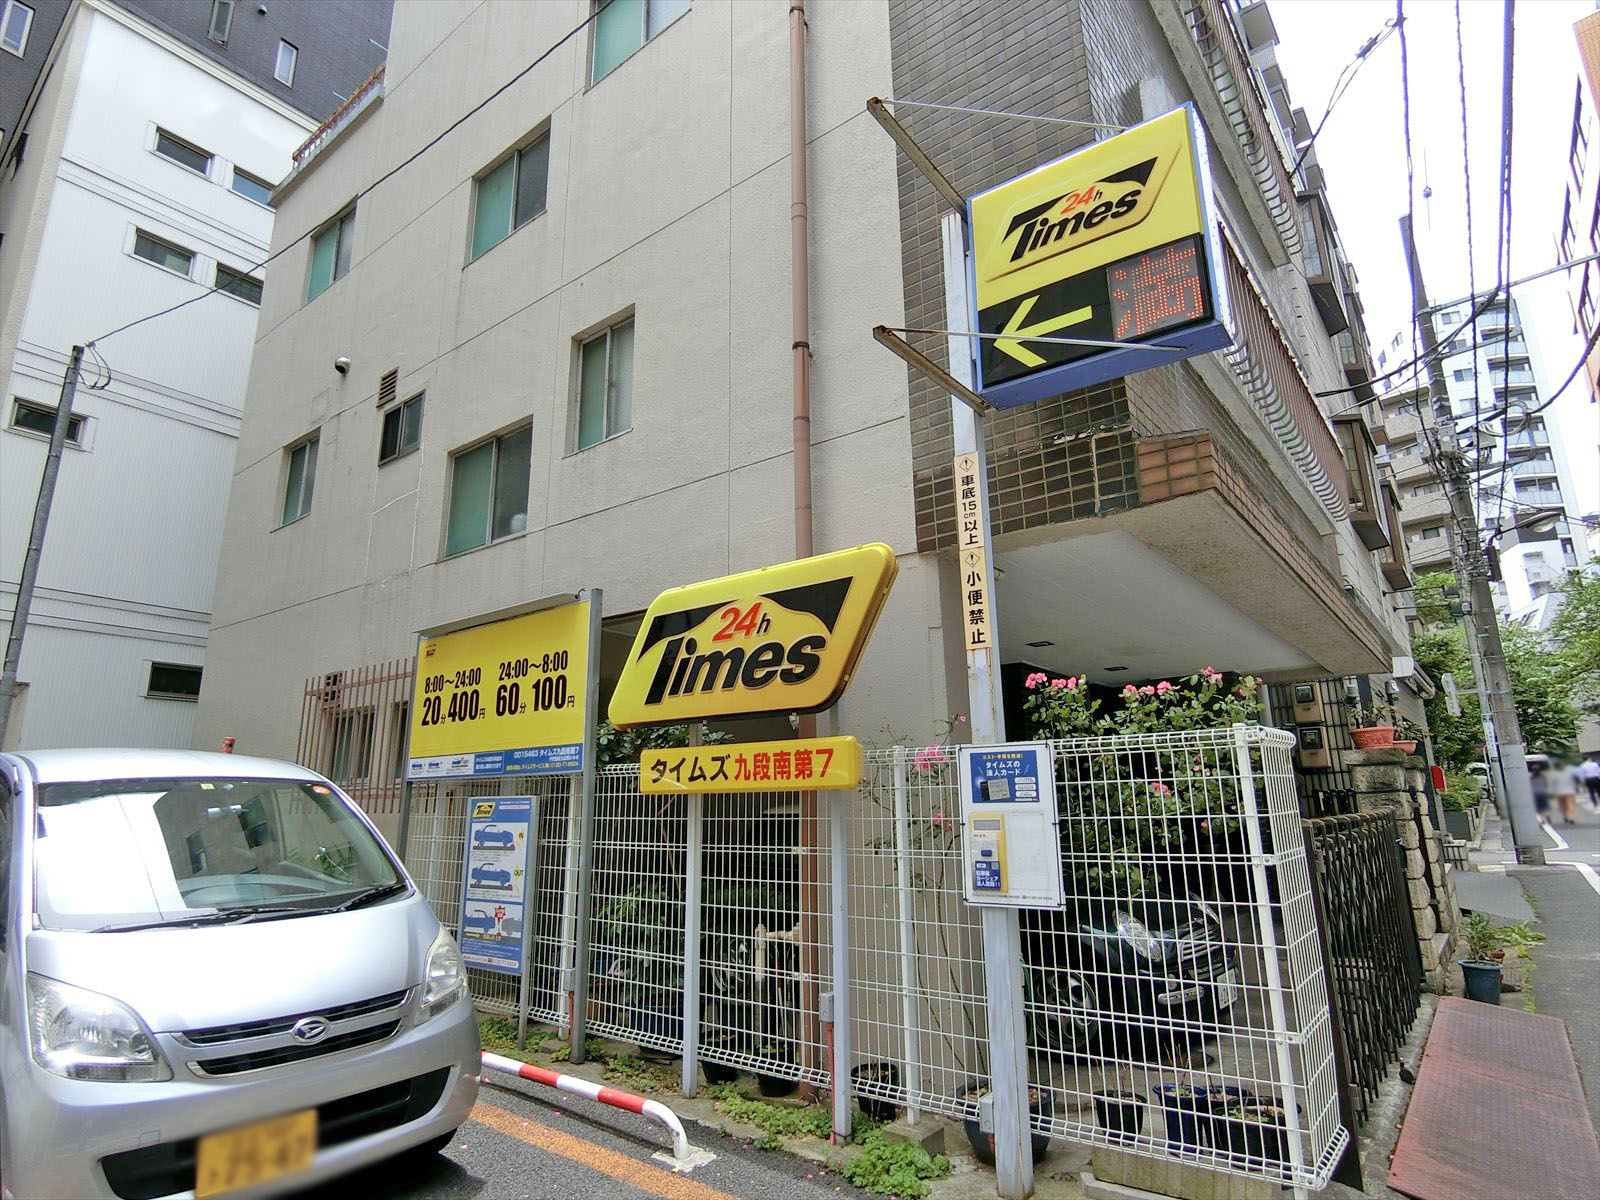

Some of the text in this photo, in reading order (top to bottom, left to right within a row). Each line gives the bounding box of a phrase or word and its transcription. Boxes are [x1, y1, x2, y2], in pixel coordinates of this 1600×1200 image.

[1060, 182, 1103, 214] 24h
[1006, 187, 1142, 262] Times
[712, 602, 770, 642] 24h
[966, 571, 986, 645] 小便禁止
[642, 634, 827, 705] Times
[985, 760, 1020, 768] タイムズの
[986, 768, 1021, 776] 法人カード
